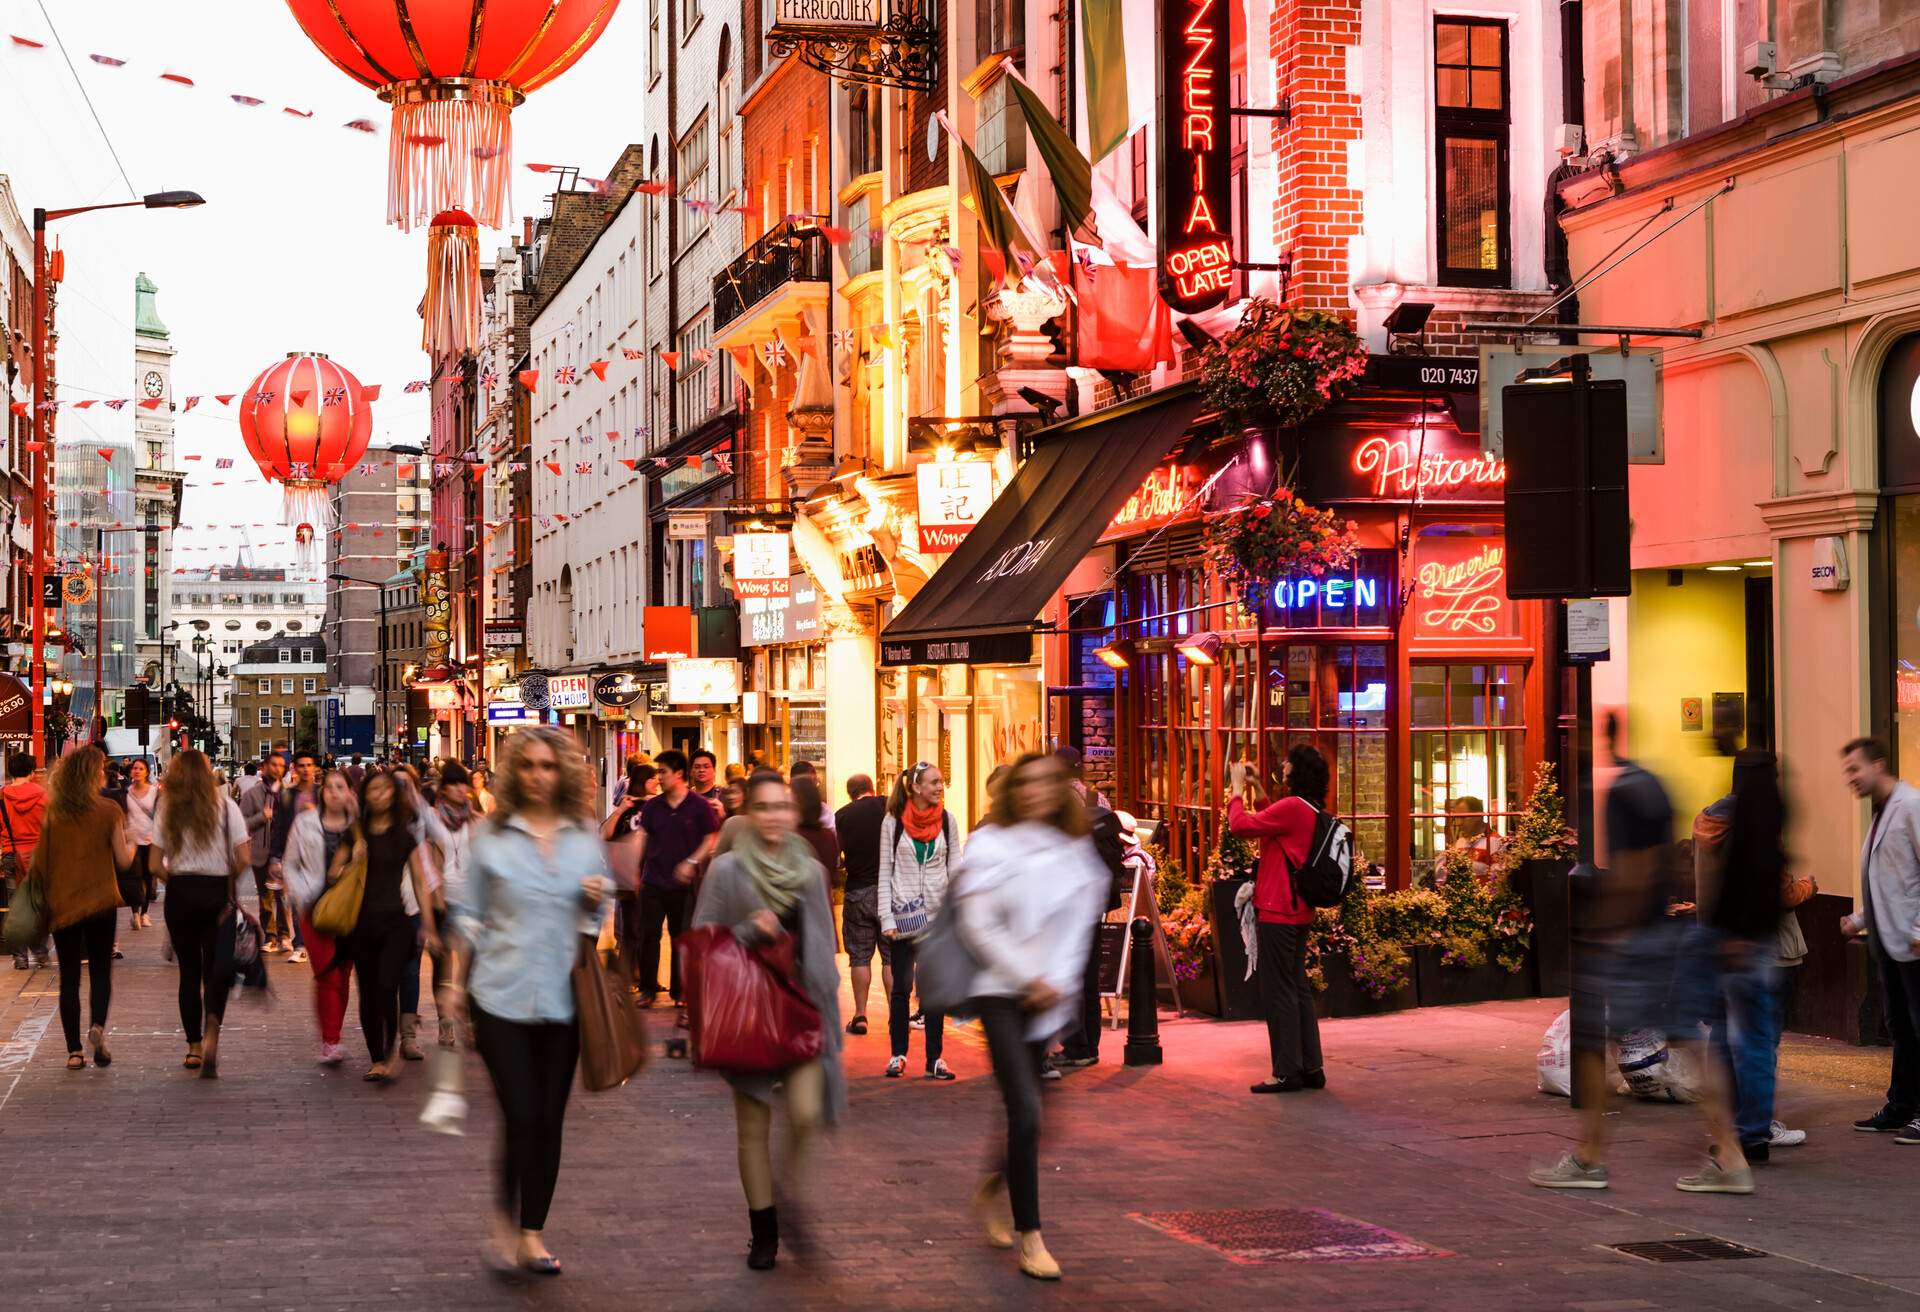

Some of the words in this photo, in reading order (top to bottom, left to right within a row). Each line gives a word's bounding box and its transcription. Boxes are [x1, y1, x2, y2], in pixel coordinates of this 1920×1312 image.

[783, 0, 872, 21] PERRUQUIER
[1169, 241, 1230, 276] OPEN
[1179, 265, 1233, 298] LATE
[1421, 367, 1446, 383] 020
[1449, 368, 1478, 384] 7437
[1420, 543, 1504, 599] Pizzeria
[1812, 566, 1836, 578] SECOM
[737, 580, 770, 596] Wong
[772, 579, 789, 593] Kei
[1274, 578, 1376, 609] OPEN
[551, 677, 586, 693] OPEN
[551, 694, 562, 707] 24
[564, 692, 588, 706] HOUR
[1270, 688, 1285, 706] br
